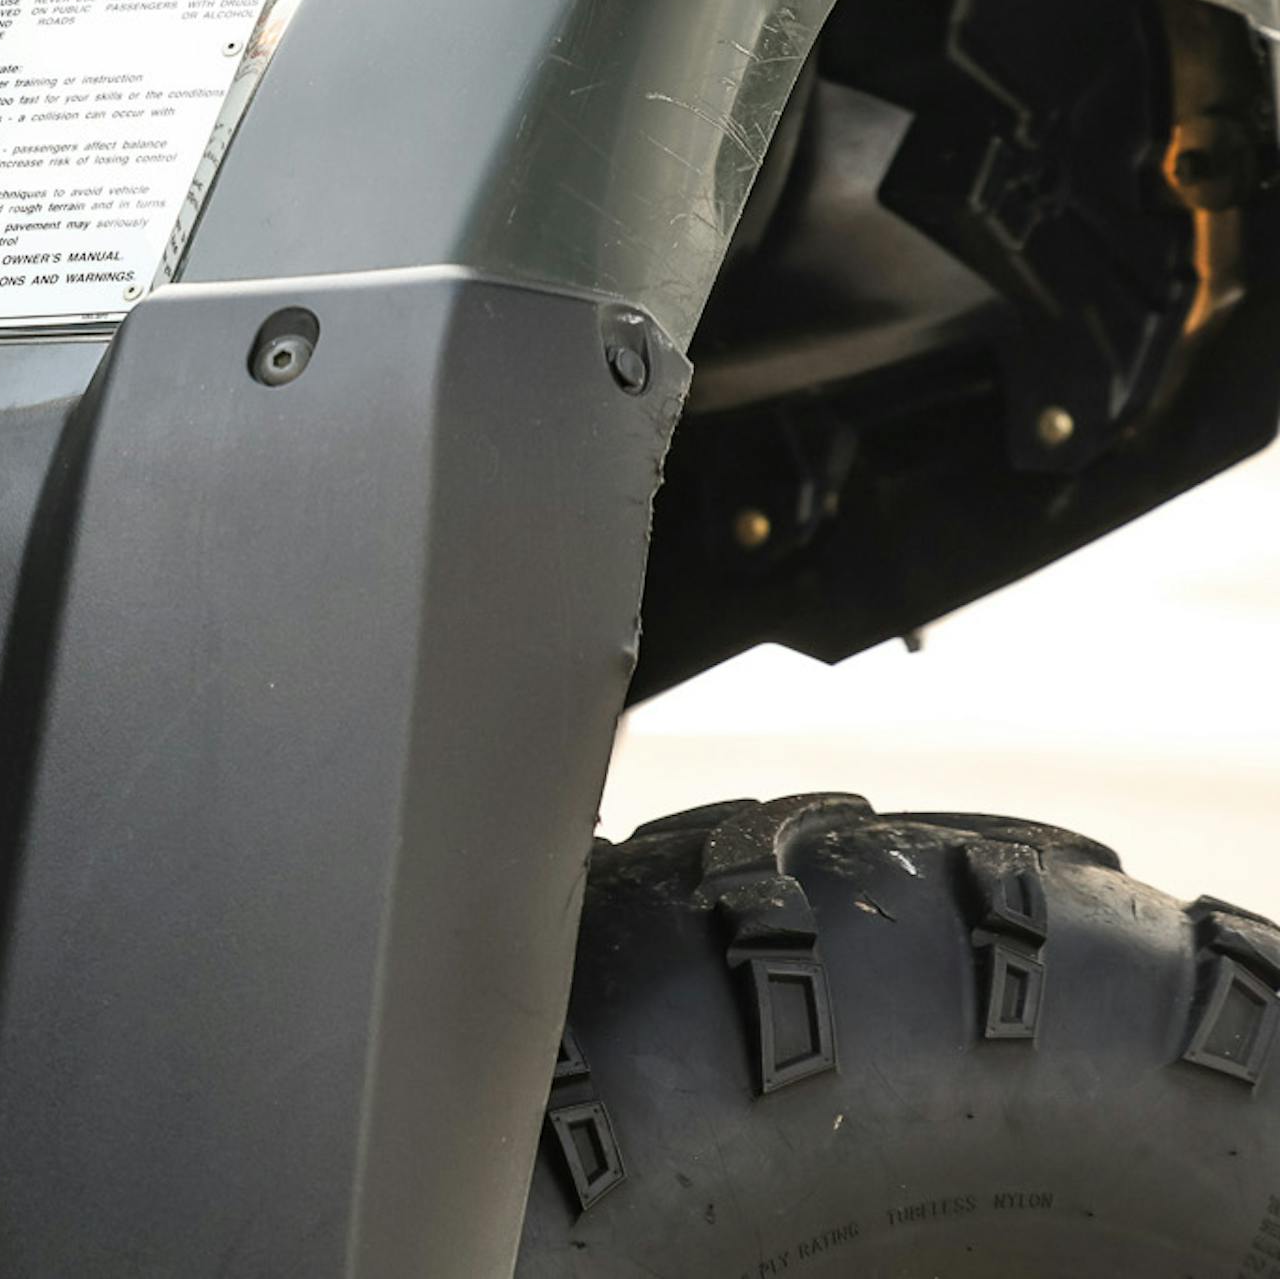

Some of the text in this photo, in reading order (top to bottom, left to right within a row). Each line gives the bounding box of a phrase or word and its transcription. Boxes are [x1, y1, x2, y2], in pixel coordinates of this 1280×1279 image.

[30, 4, 92, 16] ON PUBLIC
[105, 1, 178, 11] PASSENGERS
[187, 0, 216, 9] WITH
[38, 16, 75, 26] ROADS
[181, 9, 255, 20] OR ALCOHOL
[14, 78, 58, 89] training
[63, 77, 76, 86] or
[81, 74, 143, 84] instruction
[19, 95, 40, 105] fast
[45, 94, 61, 104] for
[65, 94, 88, 104] your
[96, 93, 122, 101] skills
[128, 92, 140, 101] or
[145, 90, 164, 100] the
[167, 88, 227, 99] conditions
[30, 112, 80, 121] collision
[84, 111, 106, 120] can
[111, 109, 145, 119] occur
[150, 106, 176, 117] with
[12, 143, 78, 156] passengers
[83, 141, 117, 151] affect
[121, 139, 168, 150] balance
[49, 157, 70, 166] risk
[76, 155, 90, 166] of
[94, 155, 130, 166] losing
[135, 153, 178, 164] control
[53, 188, 66, 198] to
[70, 186, 104, 197] avoid
[108, 185, 150, 196] vehicle
[8, 203, 43, 215] rough
[48, 203, 85, 212] terrain
[91, 200, 114, 210] and
[118, 201, 130, 209] in
[135, 199, 166, 209] turns
[4, 221, 62, 234] pavement
[66, 221, 90, 231] may
[96, 217, 149, 229] seriously
[2, 253, 62, 266] OWNER'S
[31, 274, 60, 285] AND
[758, 1192, 1055, 1279] PLY RATING TUBELESS NYLON
